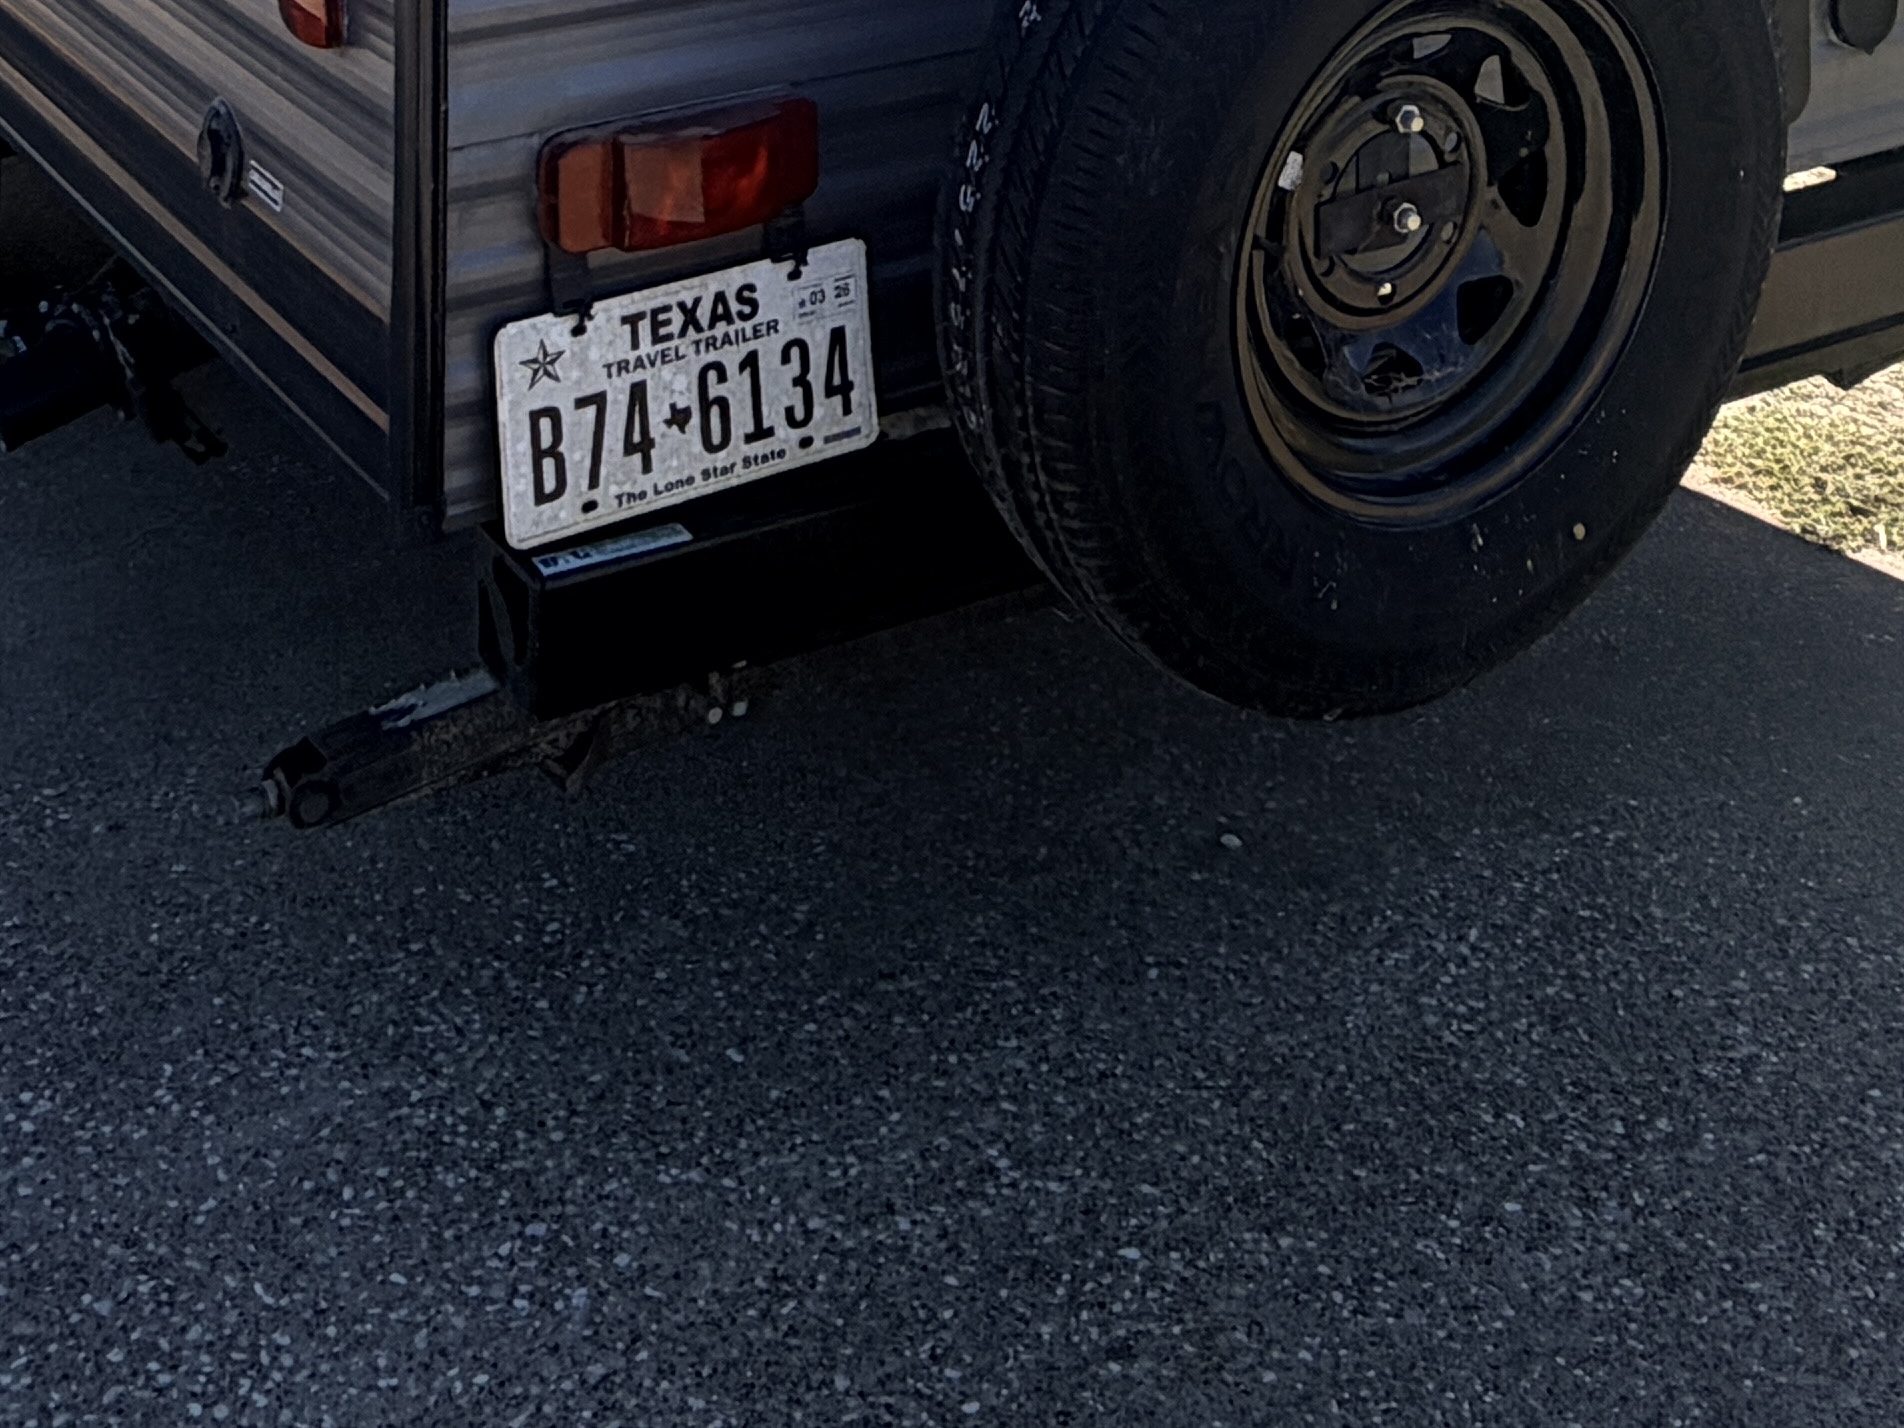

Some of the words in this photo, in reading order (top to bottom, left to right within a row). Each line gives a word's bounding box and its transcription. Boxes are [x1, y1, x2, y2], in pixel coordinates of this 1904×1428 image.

[621, 283, 760, 352] TEXAS
[602, 343, 688, 381] TRAVEL
[692, 318, 780, 357] TRAILER
[614, 487, 648, 509] The
[653, 474, 696, 496] Lone
[700, 462, 737, 483] Star
[741, 447, 787, 470] State
